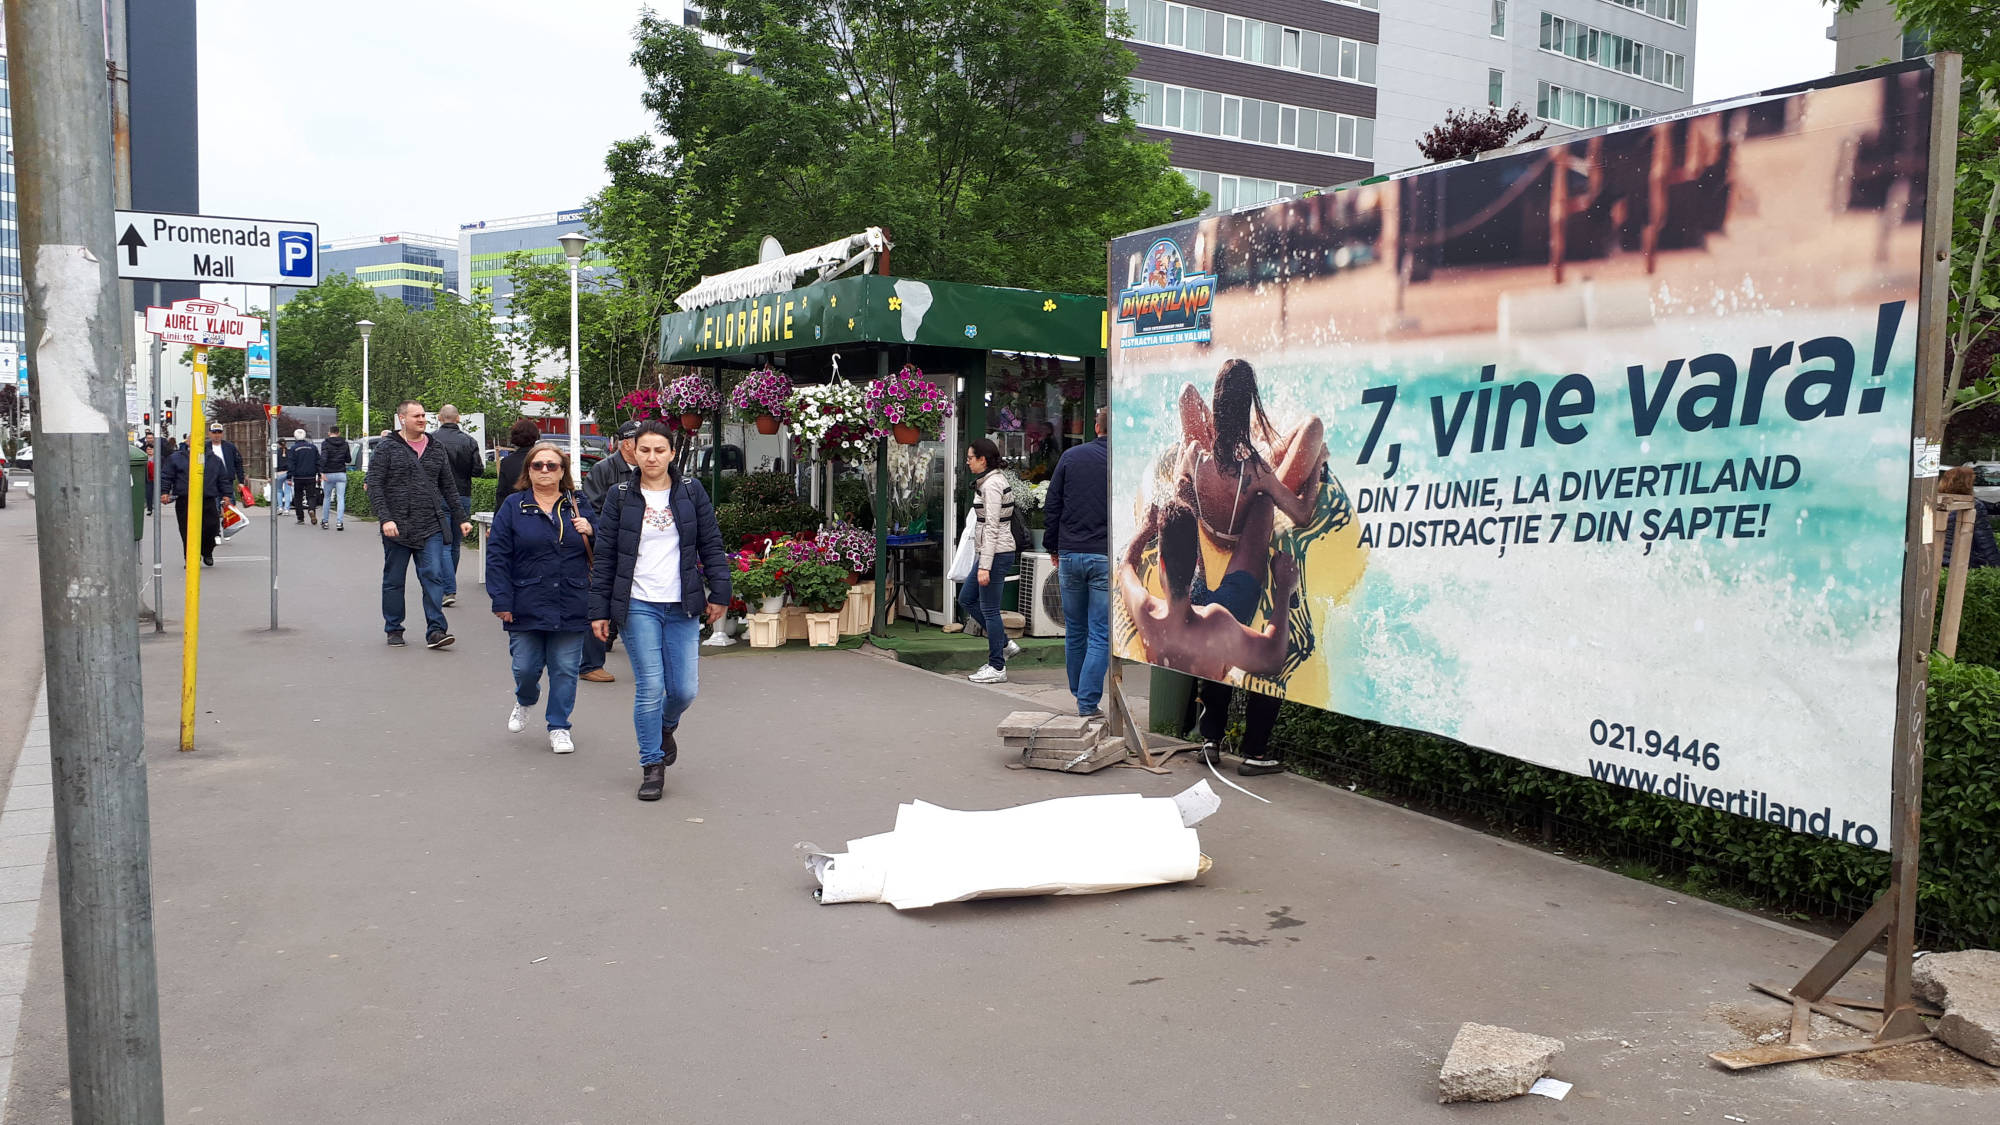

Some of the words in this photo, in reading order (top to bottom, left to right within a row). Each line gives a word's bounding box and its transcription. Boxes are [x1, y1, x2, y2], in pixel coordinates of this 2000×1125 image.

[153, 218, 270, 247] Promenada
[193, 253, 234, 278] Mall
[285, 242, 308, 271] P
[185, 303, 216, 314] STB
[1122, 286, 1210, 321] DIVERTILAND
[165, 313, 199, 332] AUREL
[206, 317, 244, 336] VLAICU
[1159, 334, 1175, 344] VINE
[1356, 384, 1401, 480] 7,
[1429, 363, 1595, 458] vine
[1627, 299, 1907, 438] vara!
[1356, 484, 1401, 514] DIN
[1403, 483, 1421, 512] 7
[1424, 477, 1503, 512] IUNIE,
[1512, 470, 1550, 505] LA
[1558, 454, 1802, 503] DIVERTILAND
[1356, 520, 1386, 549] AI
[1387, 513, 1540, 558] DISTRACȚIE
[1549, 512, 1568, 544] 7
[1572, 509, 1633, 543] DIN
[1641, 503, 1771, 556] ȘAPTE!
[1589, 718, 1721, 771] 021.9446
[1588, 758, 1879, 849] www.divertiland.ro
